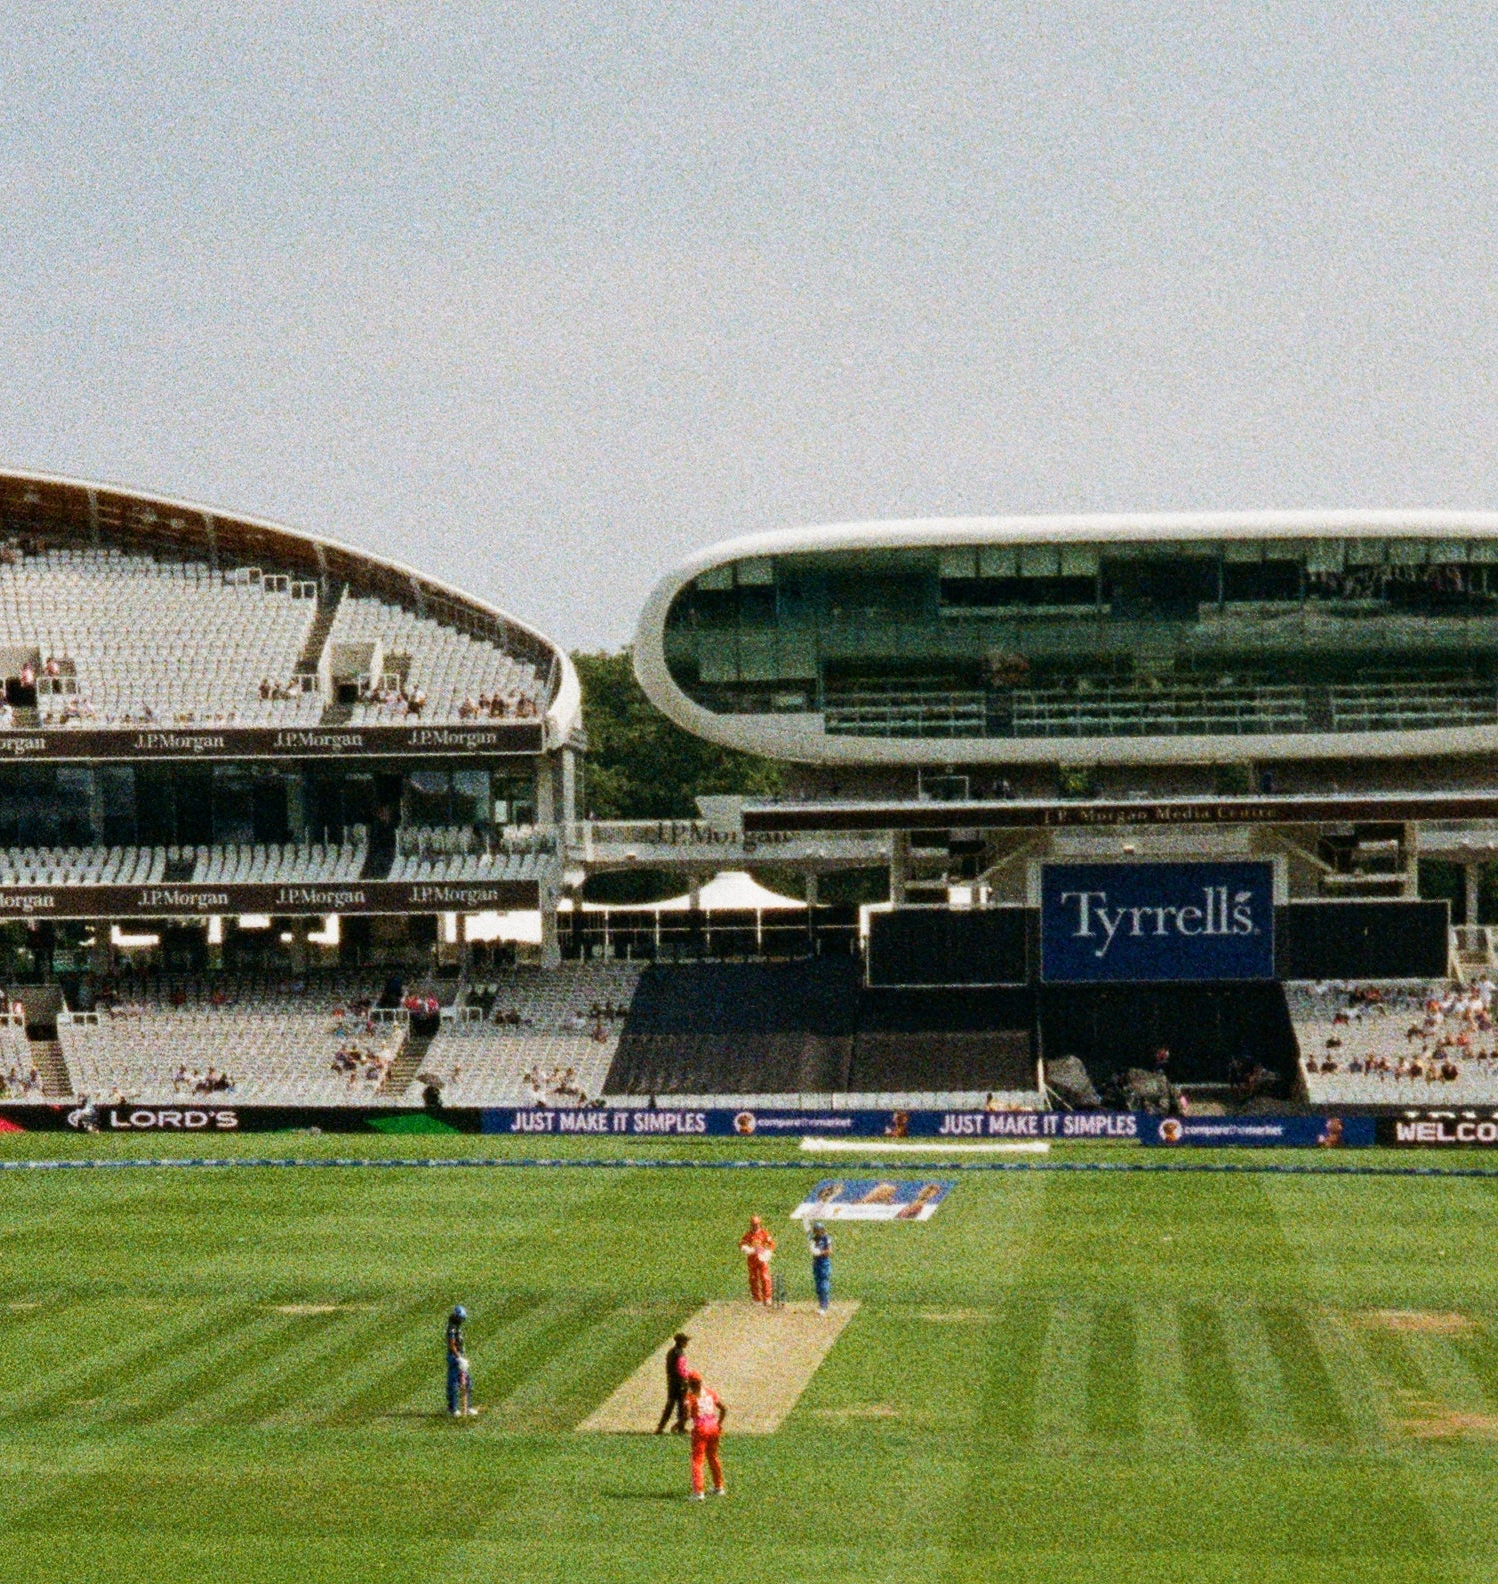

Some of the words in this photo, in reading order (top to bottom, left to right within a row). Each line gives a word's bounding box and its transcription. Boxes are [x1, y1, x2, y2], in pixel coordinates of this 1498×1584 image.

[134, 734, 224, 753] J.P.Morgan
[1156, 807, 1209, 820] Media
[138, 890, 228, 909] J.P.Morgan
[276, 888, 365, 907] J.P.Morgan
[409, 886, 498, 905] J.P.Morgan
[109, 1108, 238, 1128] LORD'S
[511, 1112, 555, 1132] JUST
[560, 1112, 608, 1132] MAKE
[612, 1112, 628, 1131] IT
[633, 1112, 705, 1132] SIMPLES
[940, 1113, 983, 1135] JUST
[989, 1114, 1039, 1135] MAKE
[1043, 1114, 1058, 1134] IT
[1063, 1115, 1137, 1136] SIMPLES
